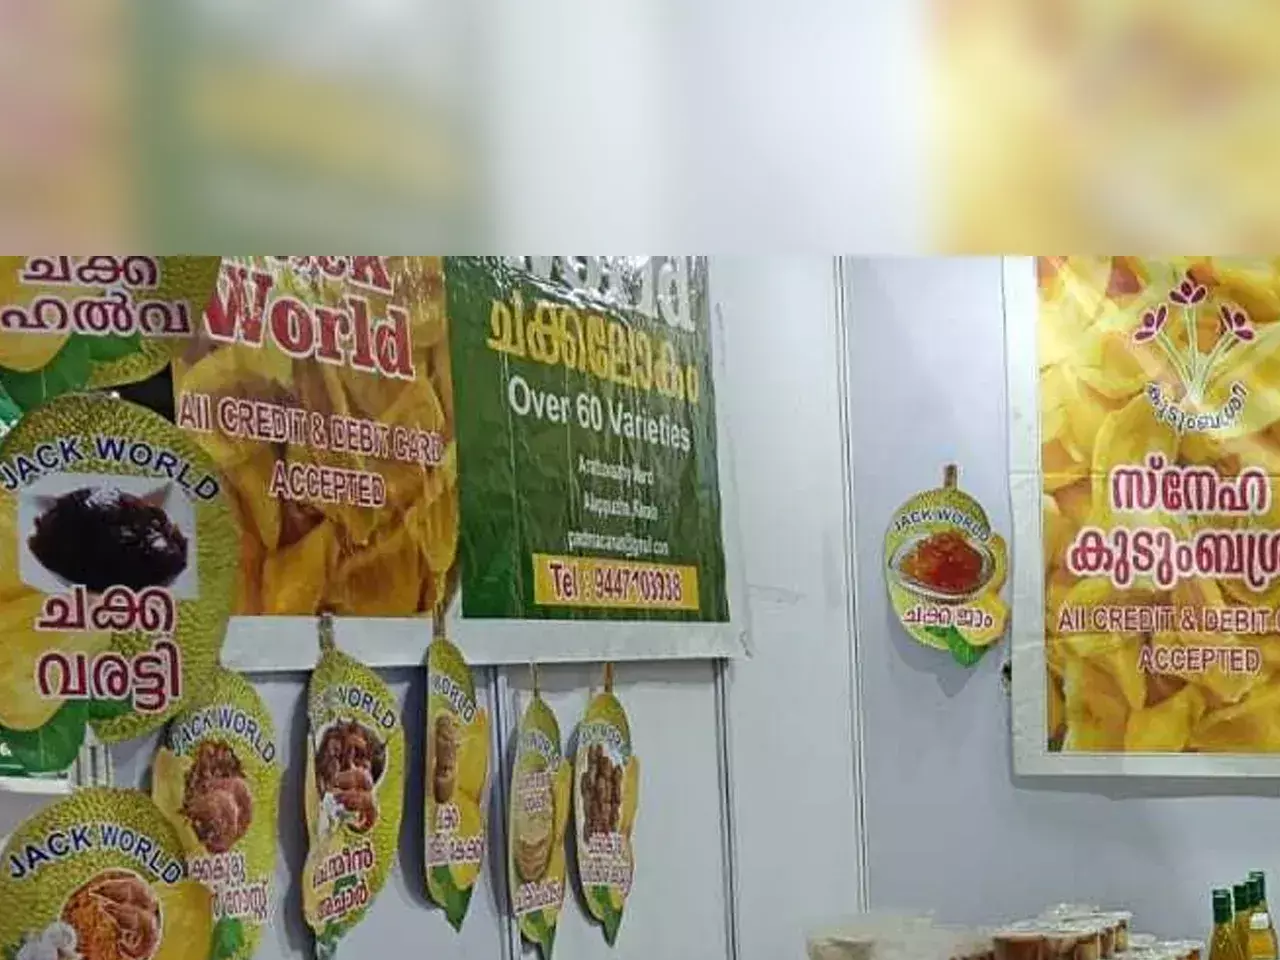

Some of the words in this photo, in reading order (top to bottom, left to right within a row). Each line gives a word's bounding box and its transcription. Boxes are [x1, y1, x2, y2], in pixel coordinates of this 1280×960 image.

[204, 262, 416, 381] World
[218, 399, 309, 441] CREDIT
[310, 413, 329, 449] &
[330, 417, 391, 460] DEBIT
[394, 428, 443, 463] CARD
[508, 375, 568, 423] Over
[576, 392, 602, 431] 60
[608, 398, 691, 452] Varieties
[1, 439, 84, 491] JACK
[98, 439, 219, 500] WORLD
[270, 462, 386, 506] ACCEPTED
[895, 511, 933, 531] JACK
[37, 587, 176, 632] ചക്ക
[550, 565, 578, 598] Tel
[1060, 607, 1085, 630] All
[1092, 606, 1175, 632] CREDIT
[1181, 606, 1196, 630] &
[1205, 607, 1269, 632] DEBIT
[37, 641, 181, 711] വരട്ടി
[1139, 647, 1261, 672] ACCEPTED
[217, 705, 276, 763] WORLD
[9, 826, 92, 879] JACK
[100, 824, 182, 884] WORLD
